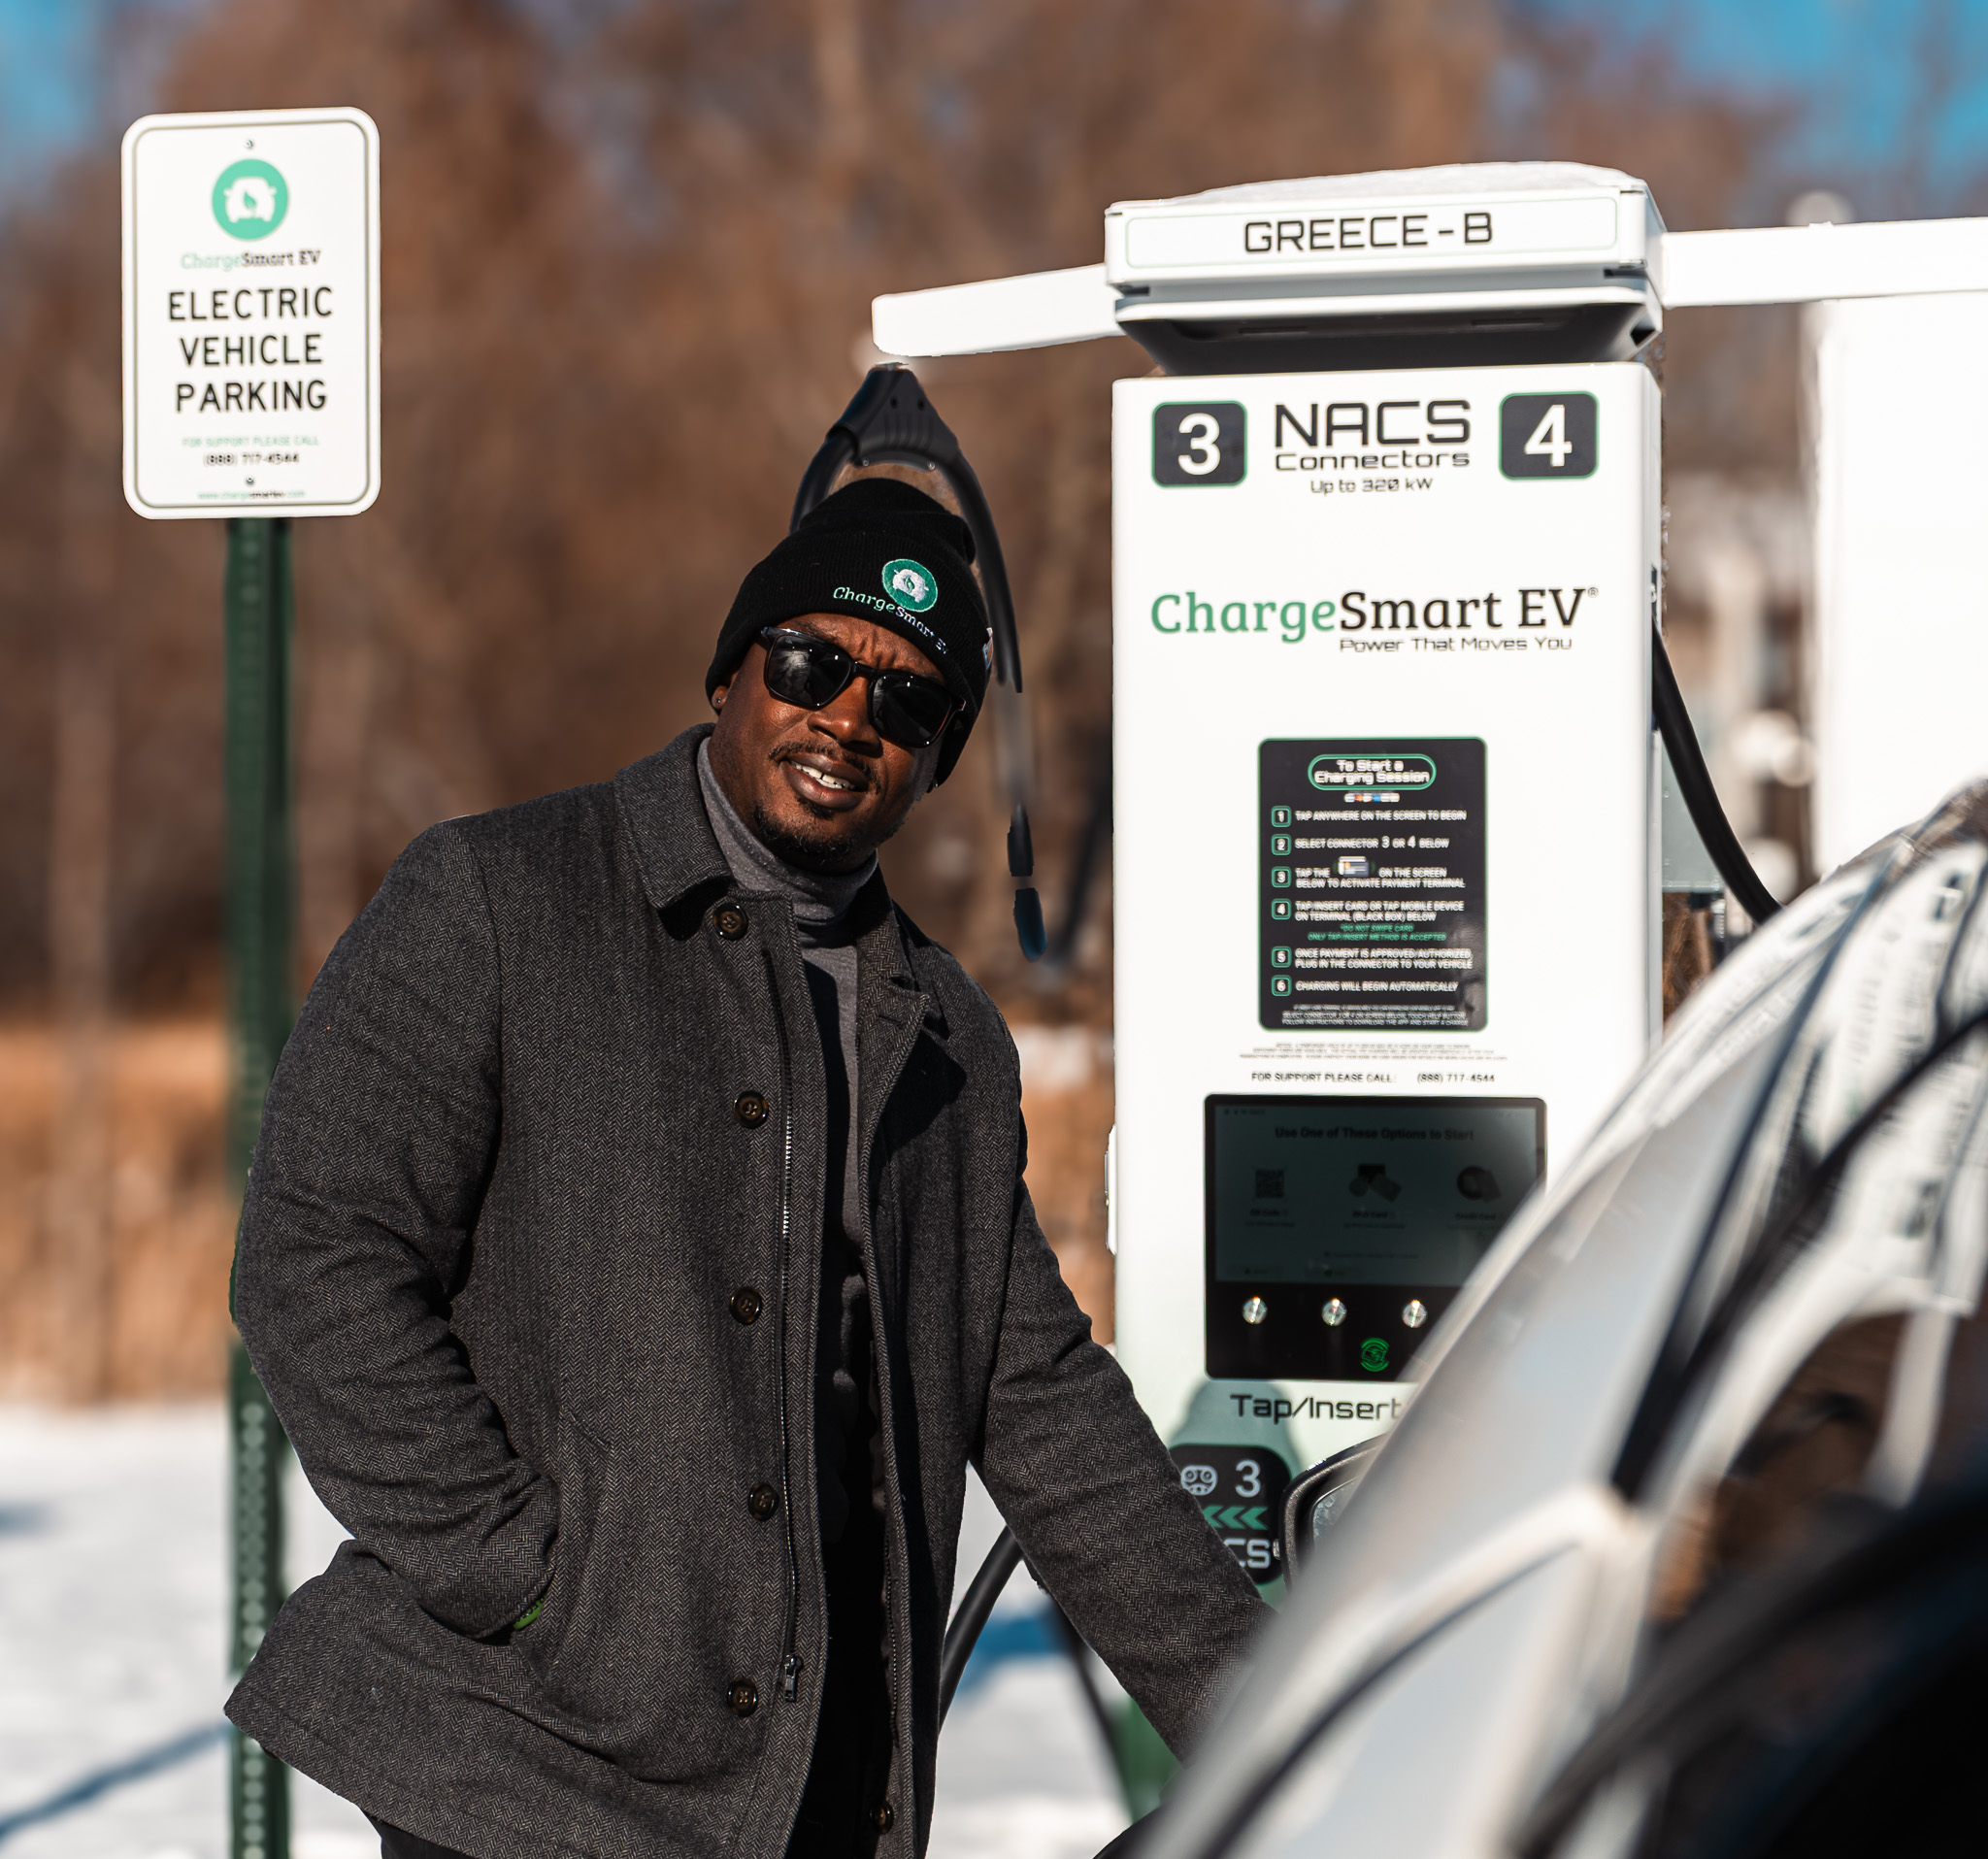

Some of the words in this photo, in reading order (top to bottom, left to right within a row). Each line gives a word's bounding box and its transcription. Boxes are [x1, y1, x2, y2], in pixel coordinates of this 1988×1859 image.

[181, 252, 293, 271] ChargeSmart
[299, 250, 320, 266] EV
[168, 287, 334, 321] ELECTRIC
[180, 334, 323, 367] VEHICLE
[177, 380, 327, 413] PARKING
[1276, 400, 1470, 447] NACS
[1524, 404, 1573, 467] 4
[182, 438, 200, 448] FOR
[206, 437, 249, 448] SUPPORT
[253, 437, 290, 447] PLEASE
[295, 437, 318, 446] CALL
[1178, 413, 1221, 476] 3
[204, 453, 237, 466] (888)
[242, 452, 299, 464] 717-4544
[1276, 450, 1470, 472] Connectors
[1310, 480, 1333, 495] Up
[1339, 479, 1355, 492] to
[1363, 479, 1398, 492] 320
[1406, 478, 1433, 491] kW
[1151, 590, 1503, 644] ChargeSmart
[1340, 638, 1404, 652] Power
[1410, 637, 1455, 651] That
[1462, 637, 1528, 651] Moves
[1535, 636, 1573, 650] You
[1337, 759, 1354, 772] To
[1356, 759, 1392, 772] Start
[1394, 760, 1404, 772] a
[1314, 771, 1375, 785] Charging
[1376, 771, 1430, 783] Session
[1277, 811, 1284, 822] 1
[1295, 811, 1312, 821] TAP
[1312, 811, 1359, 821] ANYWHERE
[1361, 811, 1374, 821] ON
[1375, 811, 1392, 821] THE
[1394, 811, 1426, 821] SCREEN
[1427, 811, 1439, 821] TO
[1441, 811, 1468, 821] BEGIN
[1277, 839, 1285, 851] 2
[1295, 838, 1326, 848] SELECT
[1327, 838, 1378, 848] CONNECTOR
[1382, 836, 1390, 848] 3
[1392, 838, 1406, 848] OR
[1408, 835, 1415, 848] 4
[1419, 838, 1450, 848] BELOW
[1277, 871, 1285, 883] 3
[1295, 868, 1312, 878] TAP
[1313, 868, 1330, 878] THE
[1378, 868, 1392, 878] ON
[1394, 868, 1409, 878] THE
[1411, 868, 1446, 878] SCREEN
[1296, 878, 1326, 888] BELOW
[1327, 878, 1340, 888] TO
[1340, 878, 1380, 888] ACTIVATE
[1381, 878, 1421, 888] PAYMENT
[1423, 878, 1466, 888] TERMINAL
[1276, 904, 1285, 914] 4
[1295, 901, 1343, 911] TAP/INSERT
[1345, 901, 1369, 911] CARD
[1370, 901, 1382, 911] OR
[1382, 901, 1400, 911] TAP
[1401, 901, 1433, 911] MOBILE
[1433, 901, 1464, 911] DEVICE
[1295, 912, 1309, 921] ON
[1309, 912, 1351, 921] TERMINAL
[1353, 912, 1384, 922] (BLACK
[1384, 912, 1406, 922] BOX)
[1408, 912, 1437, 921] BELOW
[1308, 933, 1326, 942] ONLY
[1369, 933, 1400, 942] METHOD
[1401, 933, 1408, 942] IS
[1409, 933, 1446, 942] ACCEPTED
[1277, 951, 1286, 963] 5
[1295, 948, 1319, 959] ONCE
[1320, 948, 1359, 959] PAYMENT
[1361, 948, 1369, 959] IS
[1295, 959, 1318, 969] PLUG
[1319, 959, 1329, 969] IN
[1330, 959, 1346, 969] THE
[1347, 959, 1399, 969] CONNECTOR
[1400, 959, 1411, 969] TO
[1413, 959, 1437, 969] YOUR
[1437, 959, 1474, 969] VEHICLE
[1277, 980, 1285, 992] 6
[1295, 981, 1340, 992] CHARGING
[1342, 981, 1361, 992] WILL
[1363, 981, 1388, 992] BEGIN
[1389, 981, 1458, 992] AUTOMATICALLY
[1251, 1073, 1273, 1082] FOR
[1275, 1073, 1321, 1082] SUPPORT
[1325, 1073, 1364, 1082] PLEASE
[1417, 1073, 1443, 1083] (888)
[1446, 1074, 1495, 1083] 717-4544
[1276, 1126, 1297, 1138] Use
[1301, 1126, 1324, 1138] One
[1326, 1126, 1340, 1138] of
[1343, 1127, 1377, 1140] These
[1381, 1128, 1427, 1142] Options
[1430, 1128, 1441, 1140] to
[1444, 1128, 1474, 1141] Start
[1230, 1394, 1402, 1424] Tap/Insert
[1235, 1460, 1261, 1498] 3
[1223, 1538, 1272, 1569] CS
